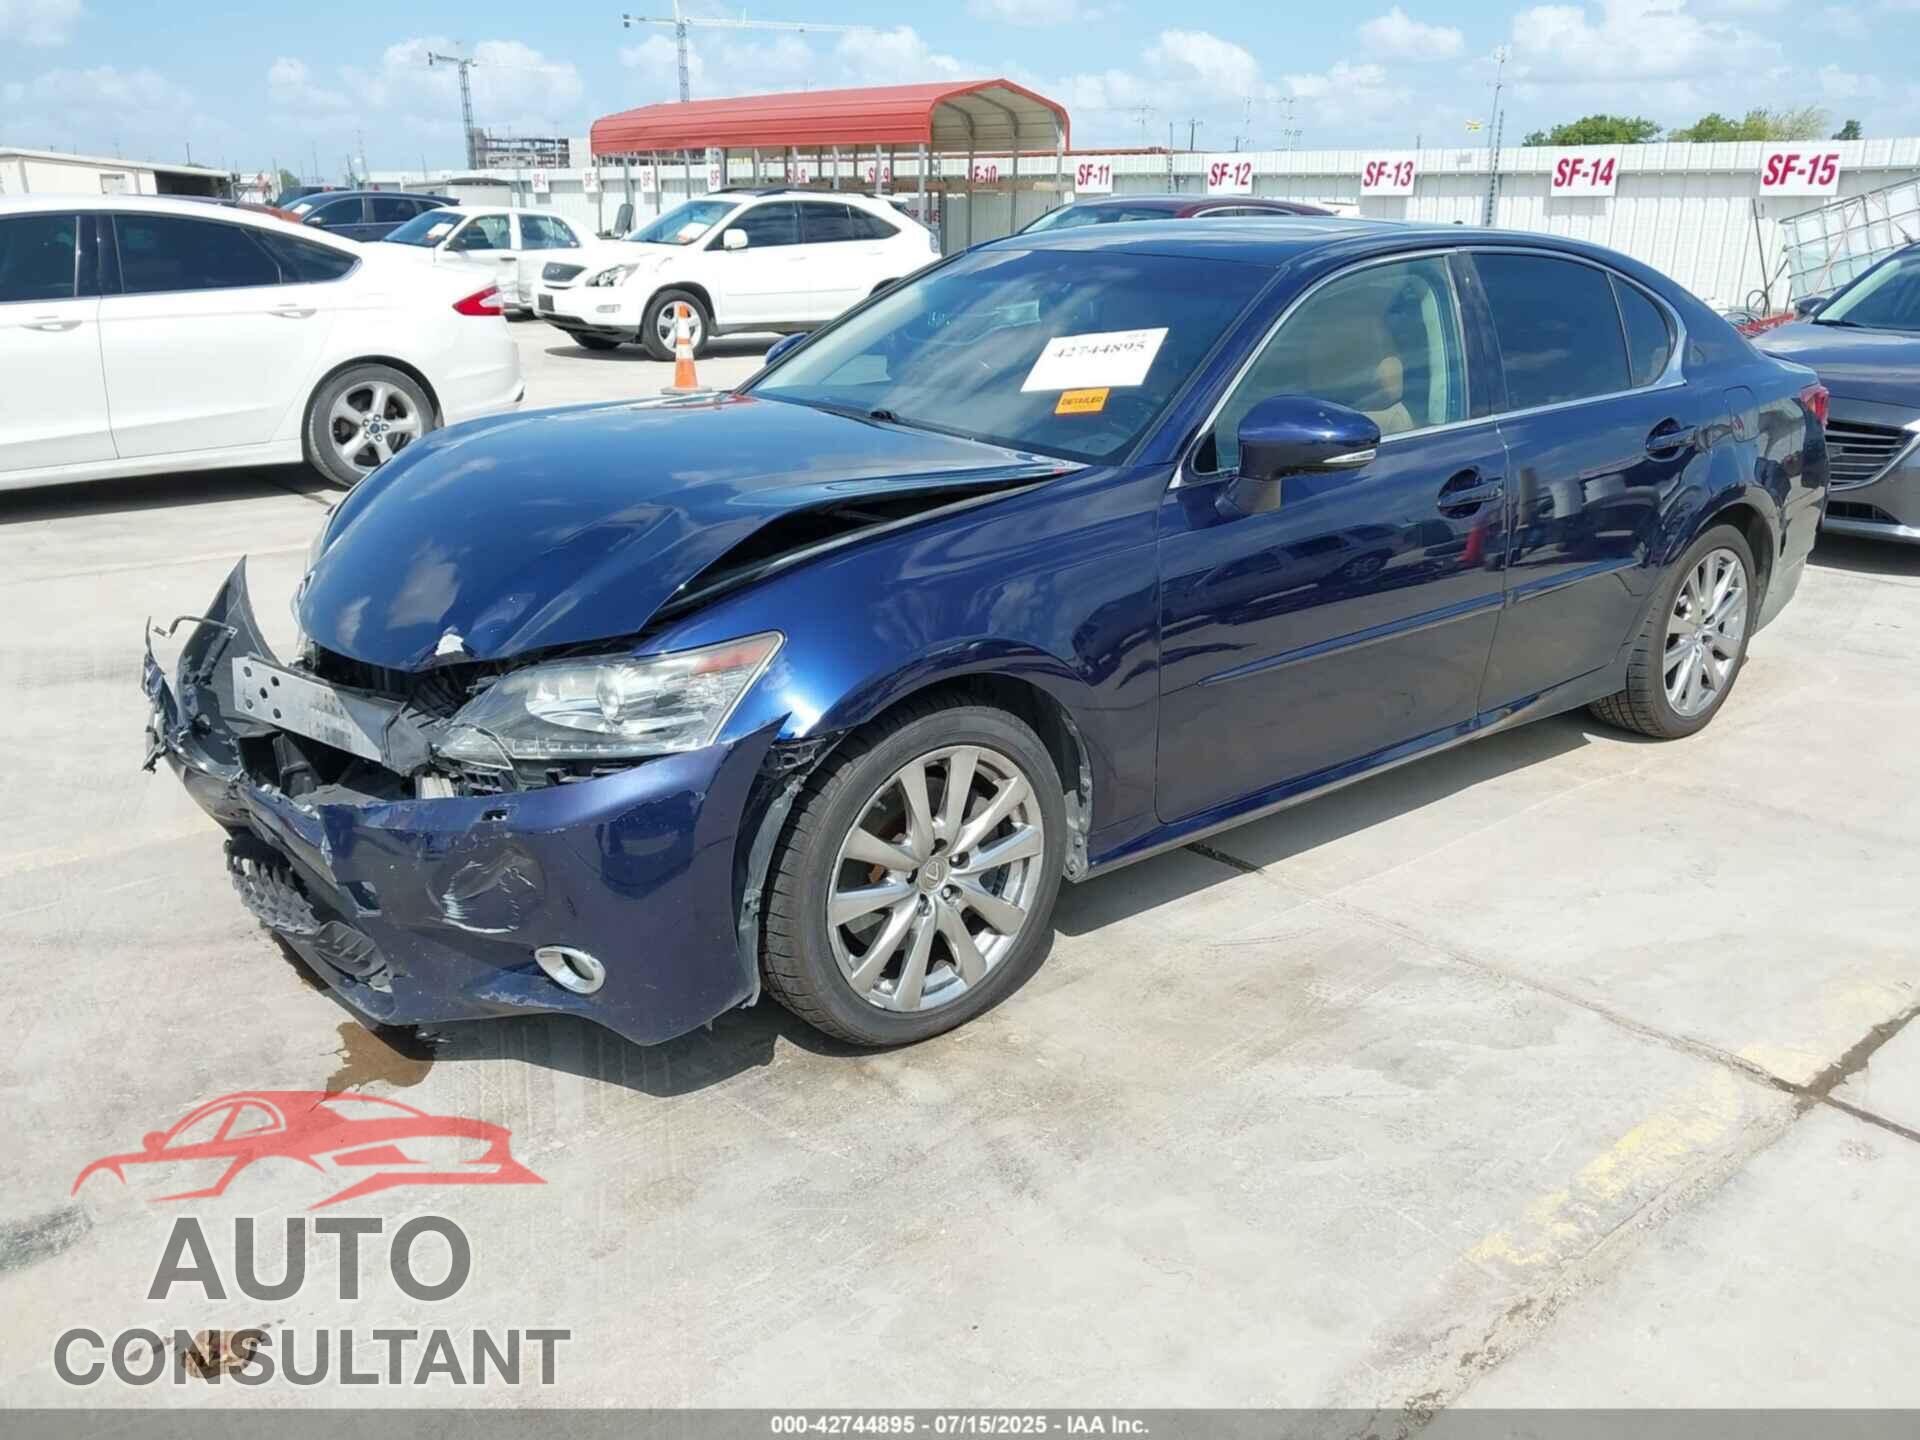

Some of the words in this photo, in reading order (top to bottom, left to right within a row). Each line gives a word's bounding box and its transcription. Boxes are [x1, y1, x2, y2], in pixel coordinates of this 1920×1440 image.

[1077, 164, 1111, 186] SF-11
[1208, 161, 1252, 186] SF-12
[1363, 160, 1414, 187] SF-13
[1553, 158, 1615, 187] SF-14
[1763, 154, 1840, 186] SF-15
[1053, 340, 1146, 358] 42744895
